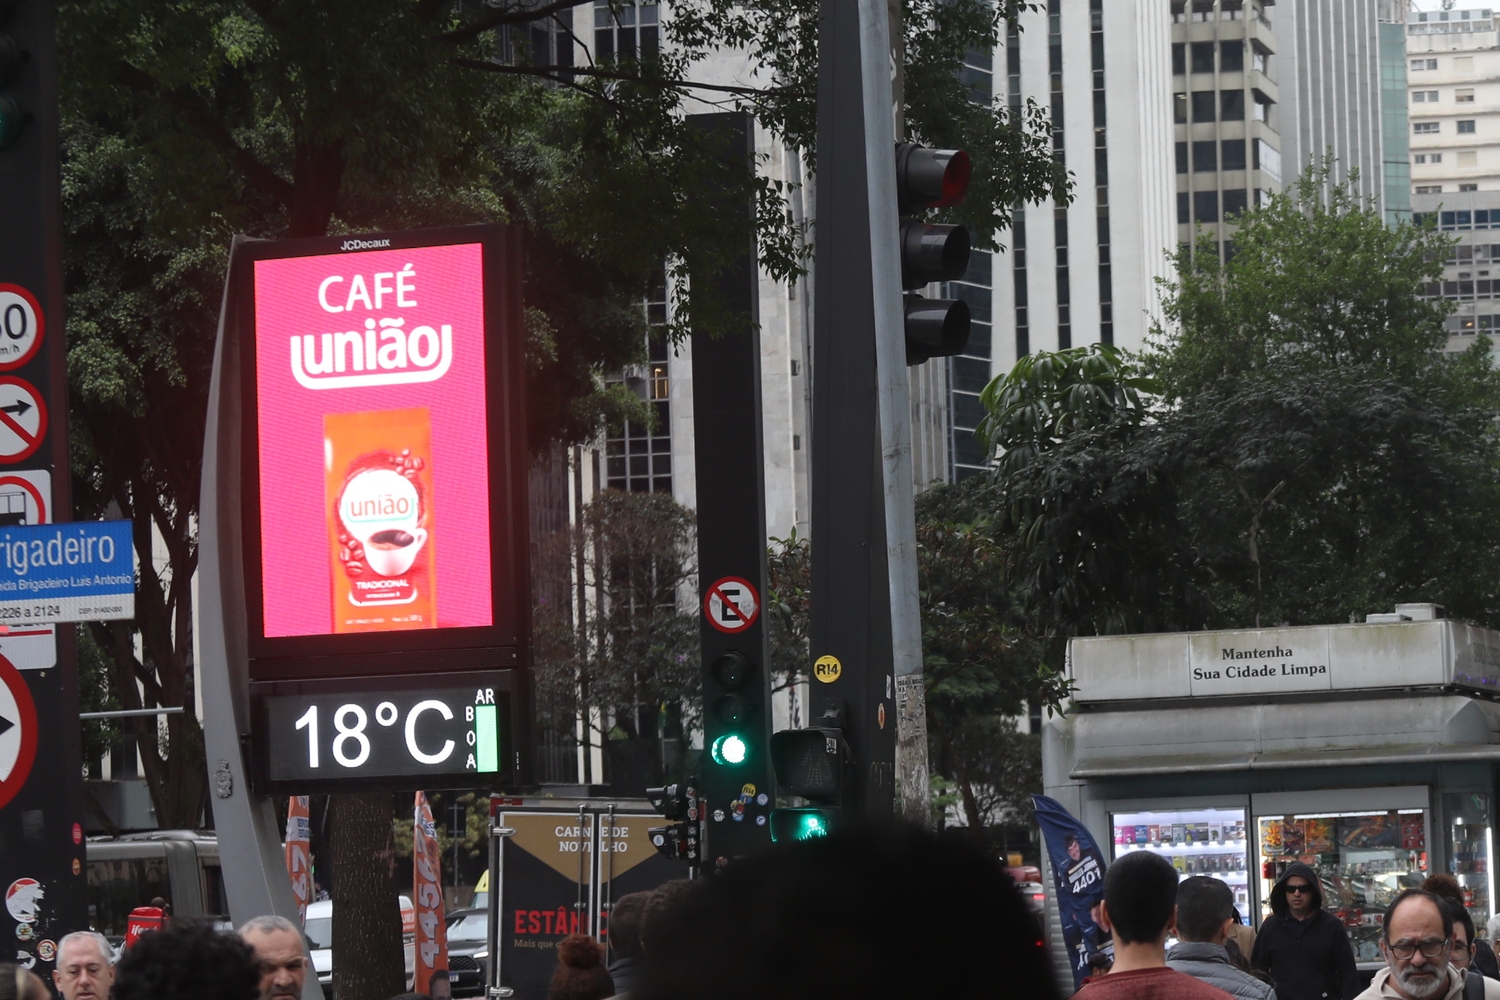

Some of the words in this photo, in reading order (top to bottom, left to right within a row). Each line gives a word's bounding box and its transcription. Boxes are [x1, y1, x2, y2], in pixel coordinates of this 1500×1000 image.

[340, 239, 390, 251] JCDecaux
[318, 263, 418, 313] CAFÉ
[0, 303, 27, 340] 0
[303, 317, 441, 375] união
[350, 493, 410, 517] união
[0, 529, 115, 576] igadeiro
[18, 577, 69, 592] Brigadeiro
[93, 573, 132, 586] Antonio
[24, 608, 31, 618] a
[34, 605, 61, 617] 2124
[1221, 645, 1294, 661] Mantenha
[816, 663, 838, 676] R14
[1193, 667, 1221, 681] Sua
[1225, 664, 1277, 679] Cidade
[1281, 663, 1327, 678] Limpa
[475, 688, 495, 705] AR
[1072, 866, 1102, 894] 4401
[514, 939, 536, 949] Mais
[537, 941, 554, 950] que
